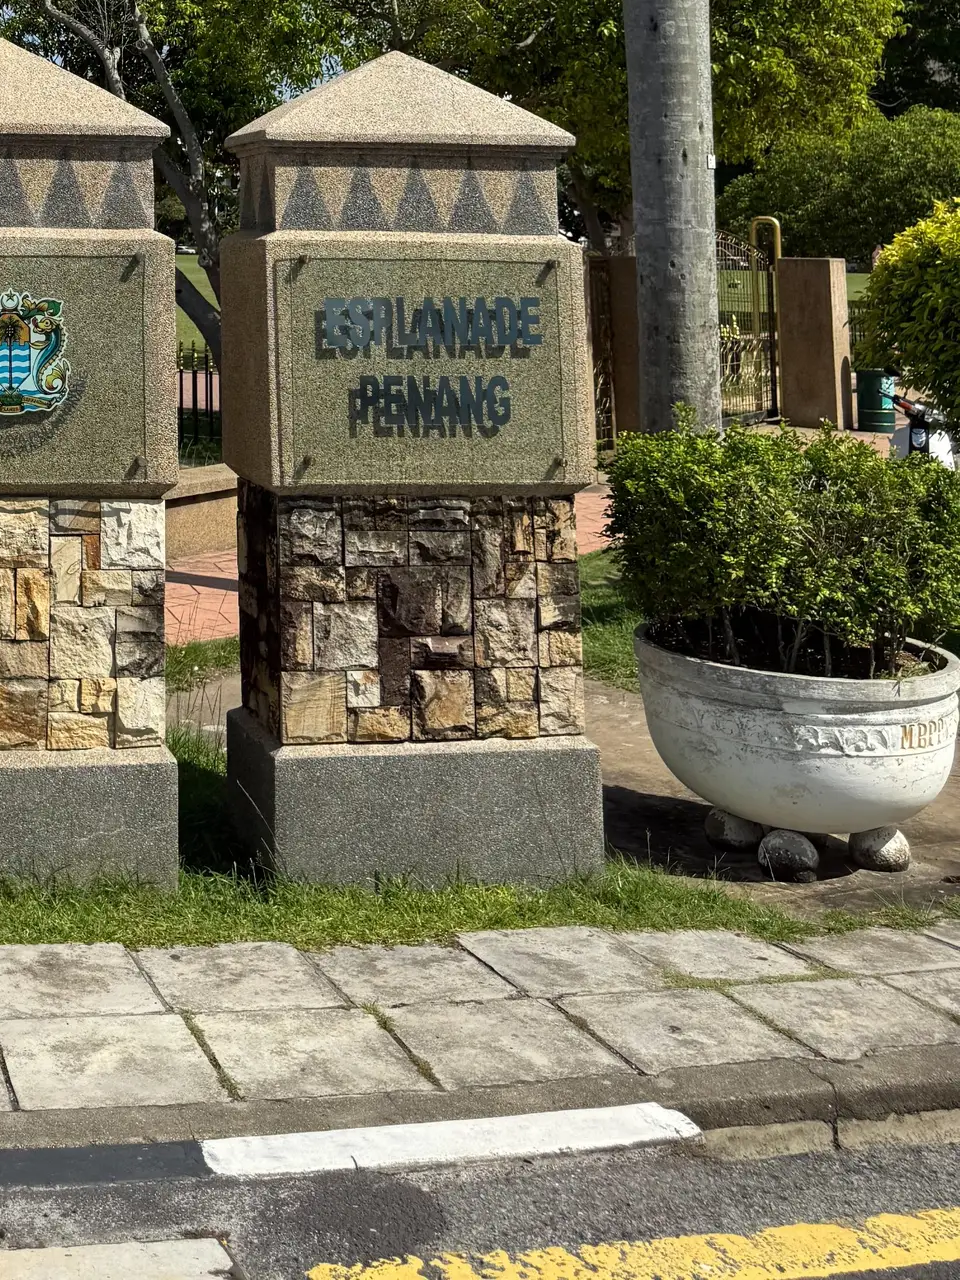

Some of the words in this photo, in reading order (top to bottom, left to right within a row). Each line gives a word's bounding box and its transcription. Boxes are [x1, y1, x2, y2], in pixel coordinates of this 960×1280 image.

[323, 297, 543, 346] ESPLANADE
[358, 375, 512, 426] PENANG
[901, 719, 944, 749] MBPP
